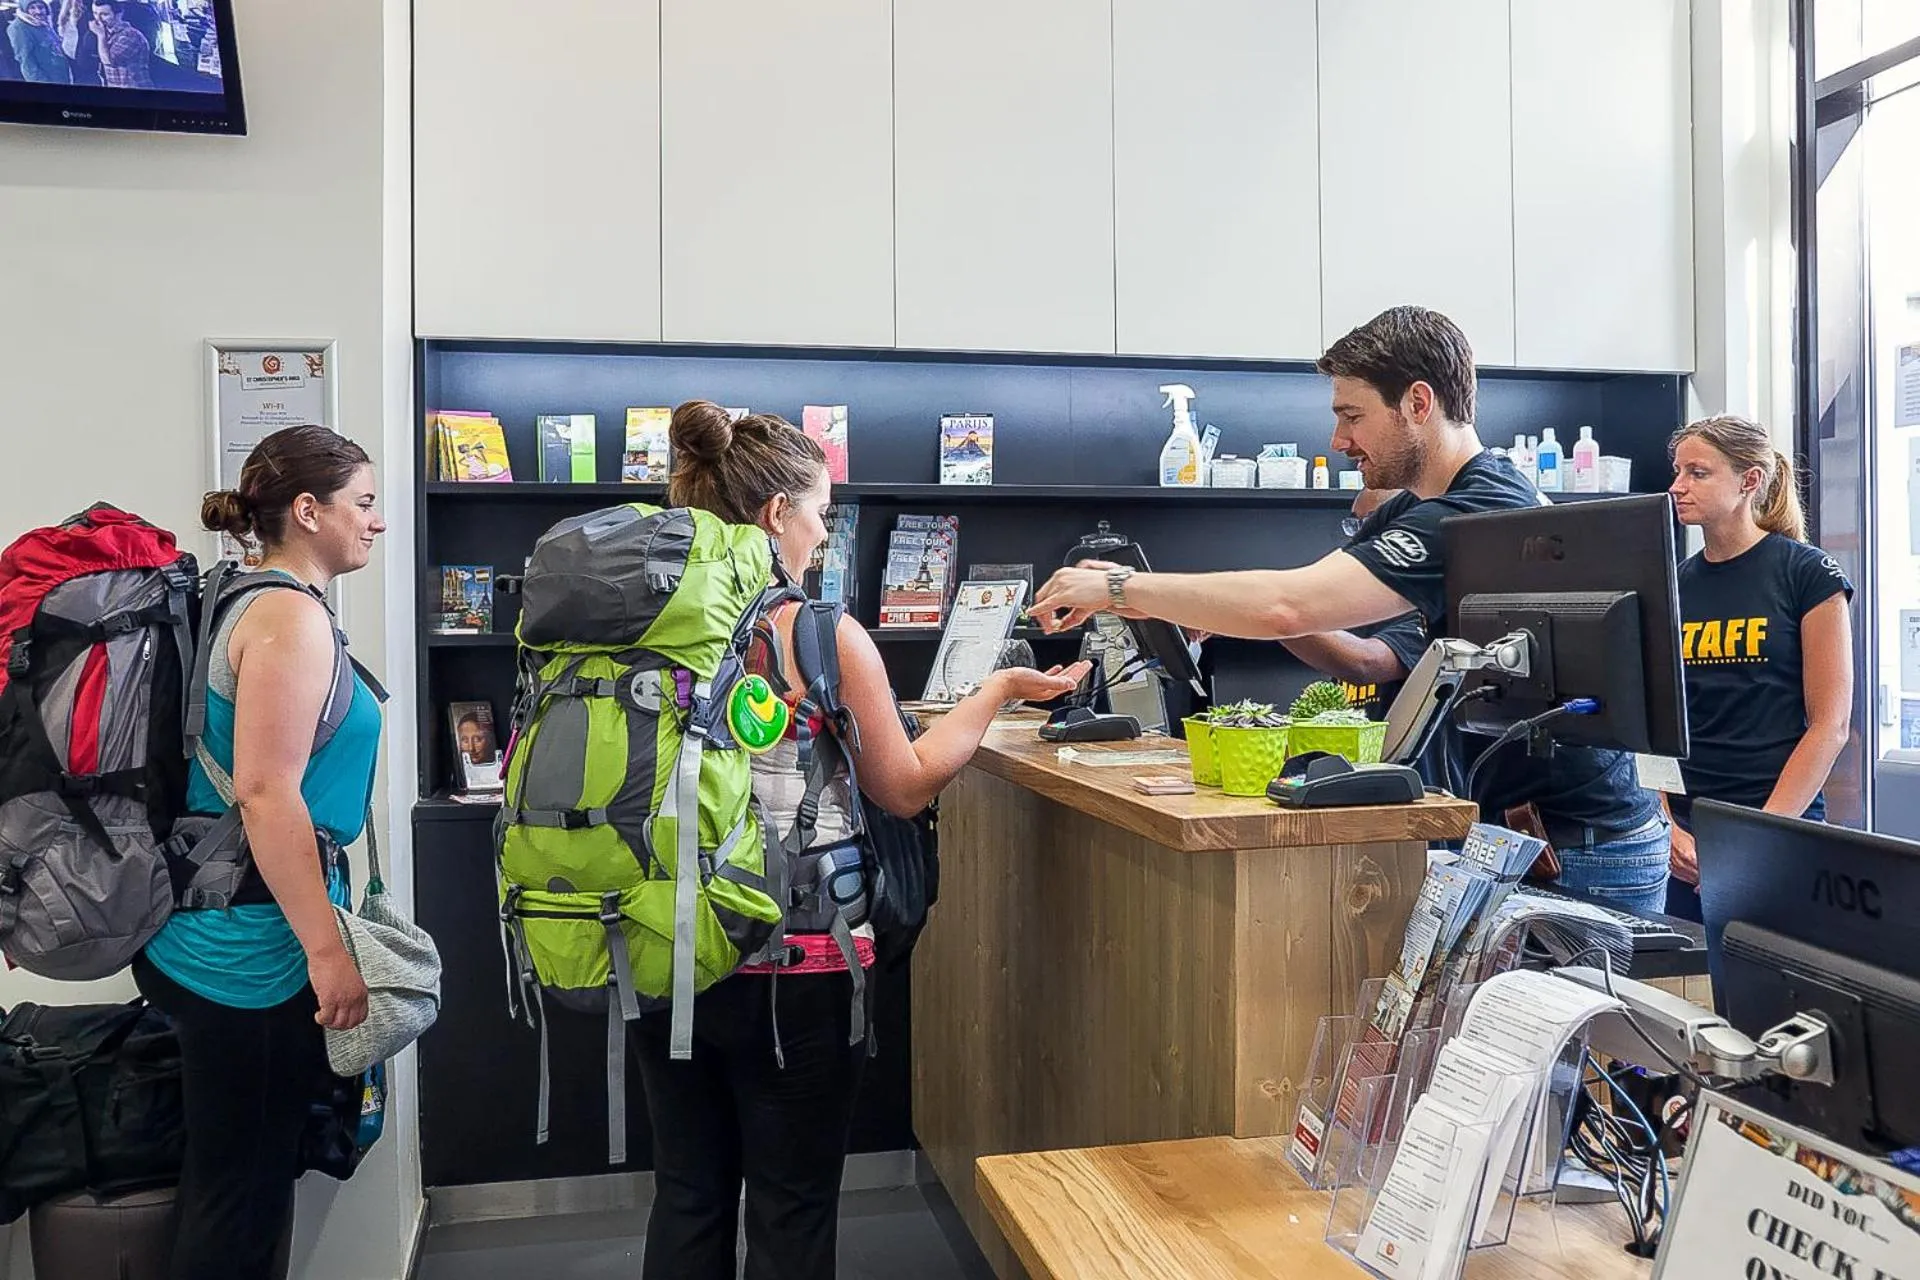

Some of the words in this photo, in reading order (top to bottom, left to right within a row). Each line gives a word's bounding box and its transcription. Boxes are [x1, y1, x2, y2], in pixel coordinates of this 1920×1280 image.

[924, 521, 951, 530] TOUR
[1682, 617, 1768, 659] TAFF
[1462, 837, 1498, 866] FREE
[1420, 875, 1445, 902] FREE
[1786, 1179, 1824, 1211] DID
[1747, 1207, 1860, 1280] CHECK
